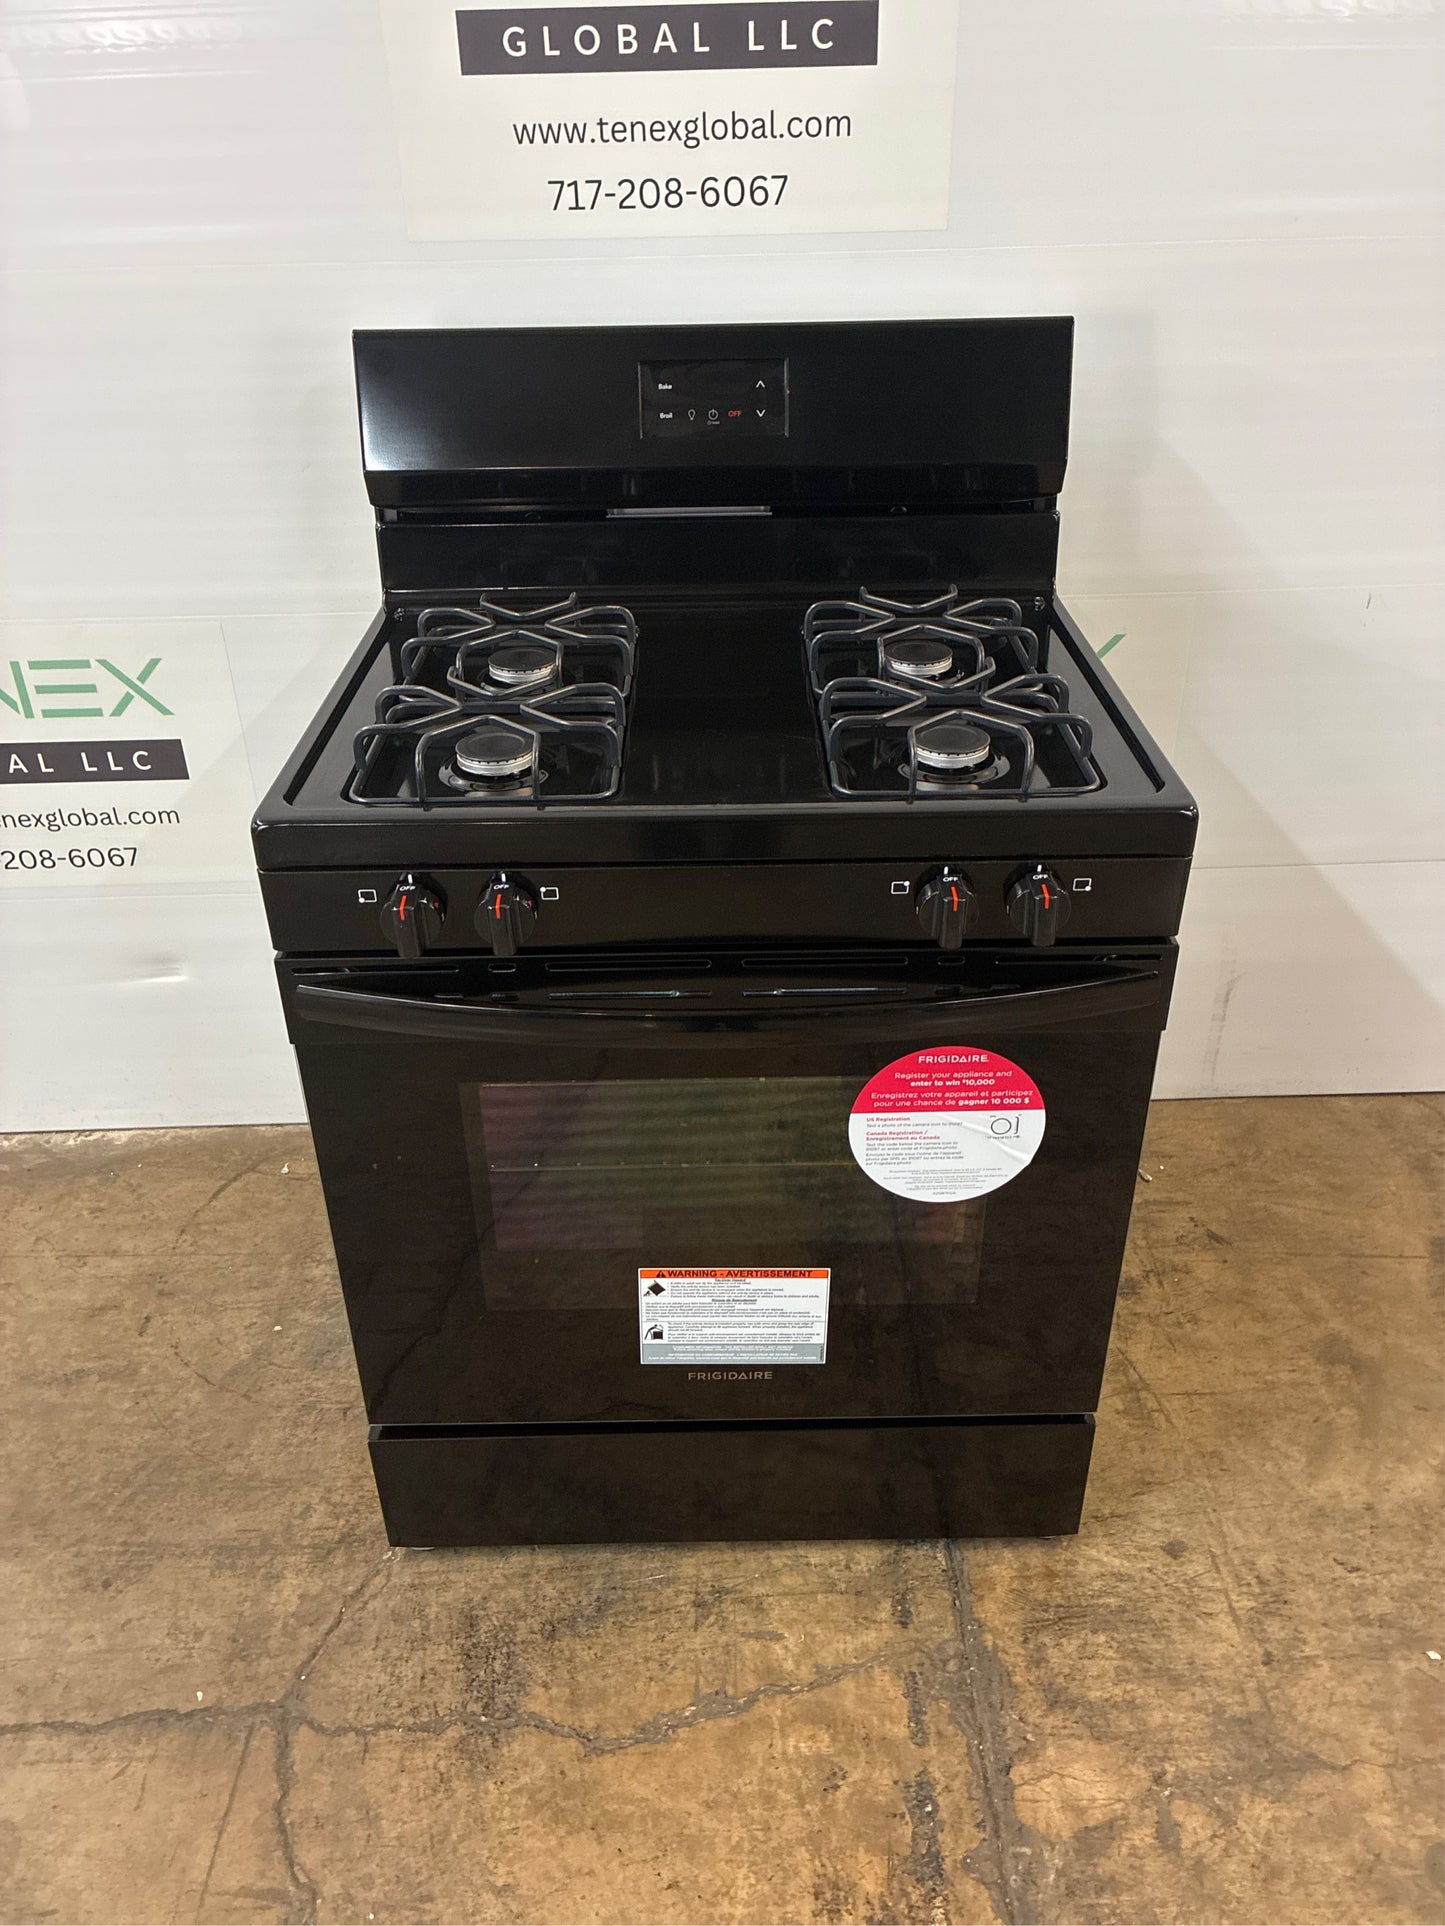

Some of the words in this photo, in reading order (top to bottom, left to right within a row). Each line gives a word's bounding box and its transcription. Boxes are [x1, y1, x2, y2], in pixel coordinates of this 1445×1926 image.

[502, 21, 710, 58] GLOBAL
[747, 18, 835, 51] LLC
[513, 110, 852, 149] www.tenexglobal.com
[548, 175, 789, 211] 717-208-6067
[8, 753, 55, 774] AL
[80, 750, 152, 772] LLC
[0, 807, 180, 832] nexglobal.com
[918, 1054, 989, 1064] FRIGIDAIRE
[894, 1072, 929, 1080] Register
[931, 1072, 950, 1080] your
[952, 1071, 993, 1079] appliance
[995, 1070, 1013, 1078] and
[871, 1092, 918, 1100] Enregistrez
[944, 1090, 978, 1099] appareil
[991, 1089, 1033, 1098] participez
[873, 1100, 893, 1108] pour
[944, 1098, 956, 1106] de
[958, 1099, 989, 1107] gagner
[667, 1269, 718, 1278] WARNING
[725, 1269, 813, 1278] AVERTISSEMENT
[687, 1371, 773, 1380] FRIGIDAIRE
